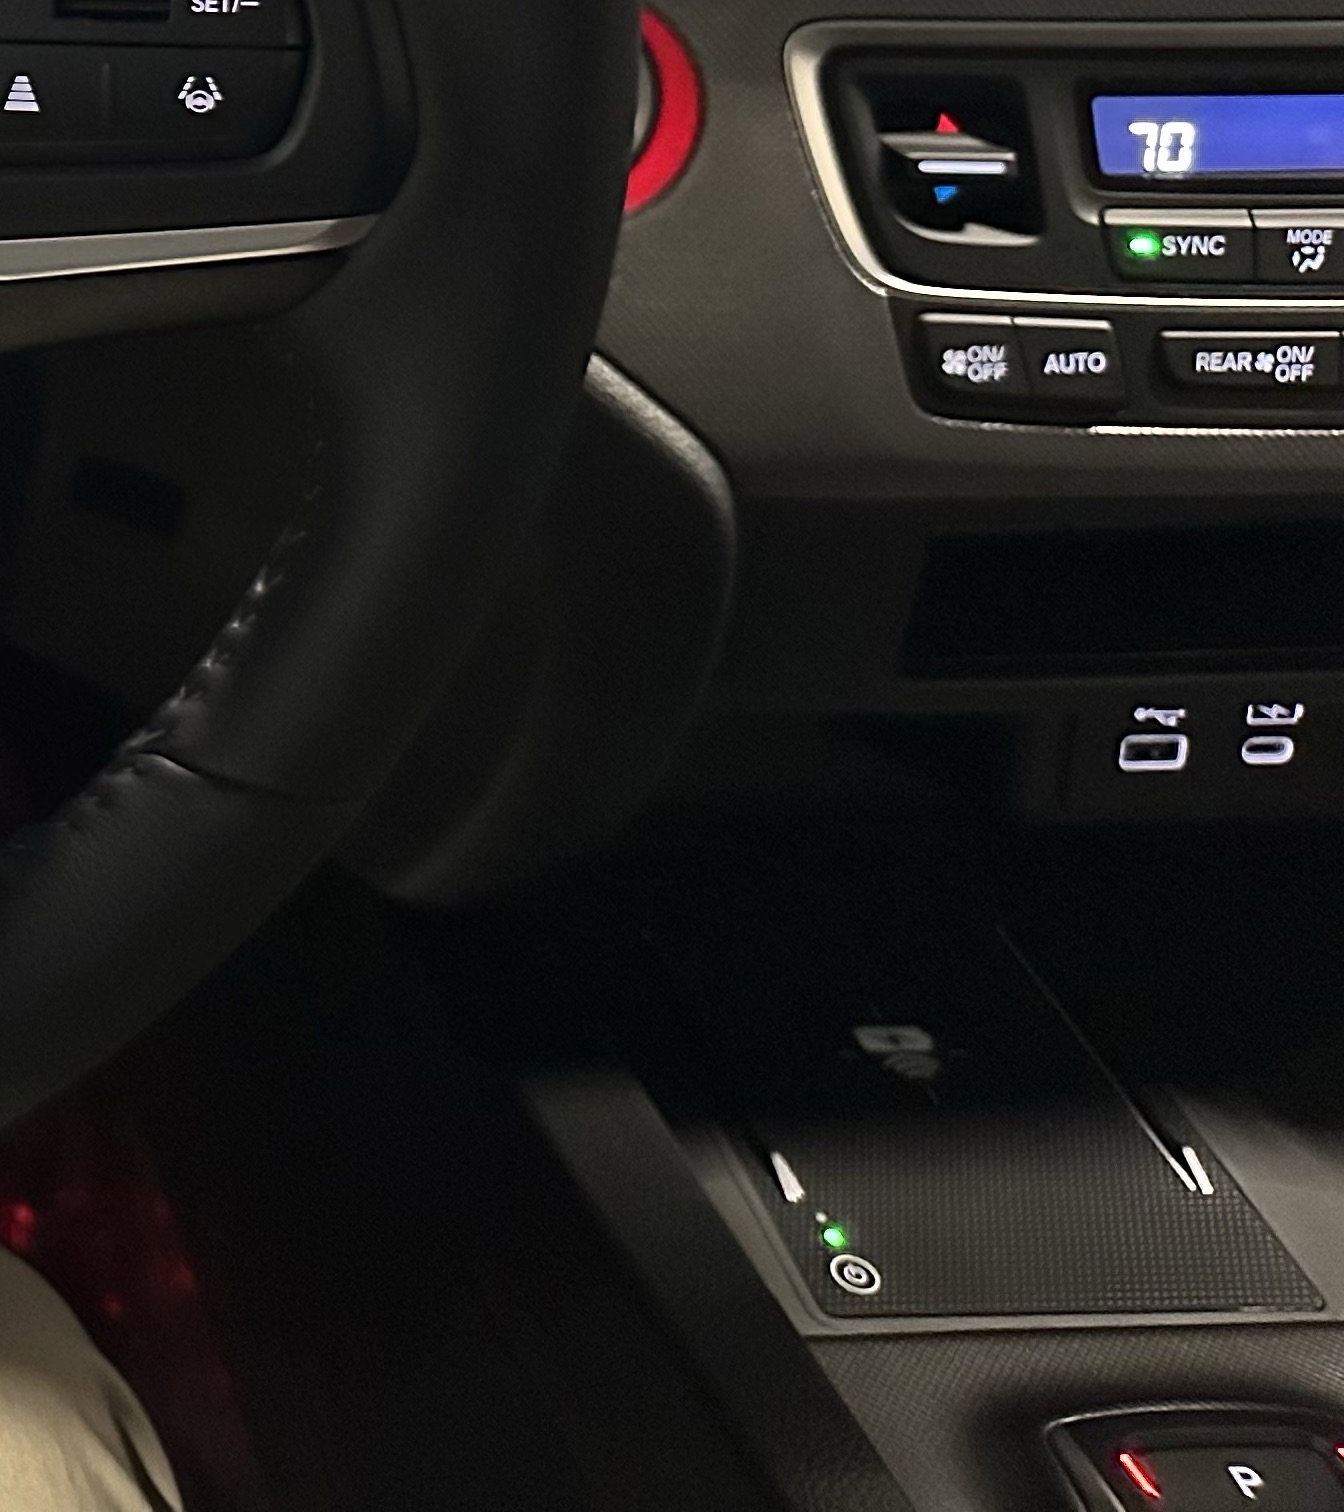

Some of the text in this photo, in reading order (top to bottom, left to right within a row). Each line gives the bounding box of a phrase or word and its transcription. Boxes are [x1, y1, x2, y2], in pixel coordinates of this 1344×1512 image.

[1128, 121, 1195, 172] 70
[1161, 235, 1226, 256] SYNC
[1286, 228, 1334, 245] MODE
[967, 345, 1007, 364] ON/
[1044, 352, 1107, 375] AUTO
[1196, 345, 1316, 373] REAR ON/
[967, 362, 1009, 382] OFF
[1274, 363, 1315, 383] OFF
[1227, 1465, 1265, 1500] P
